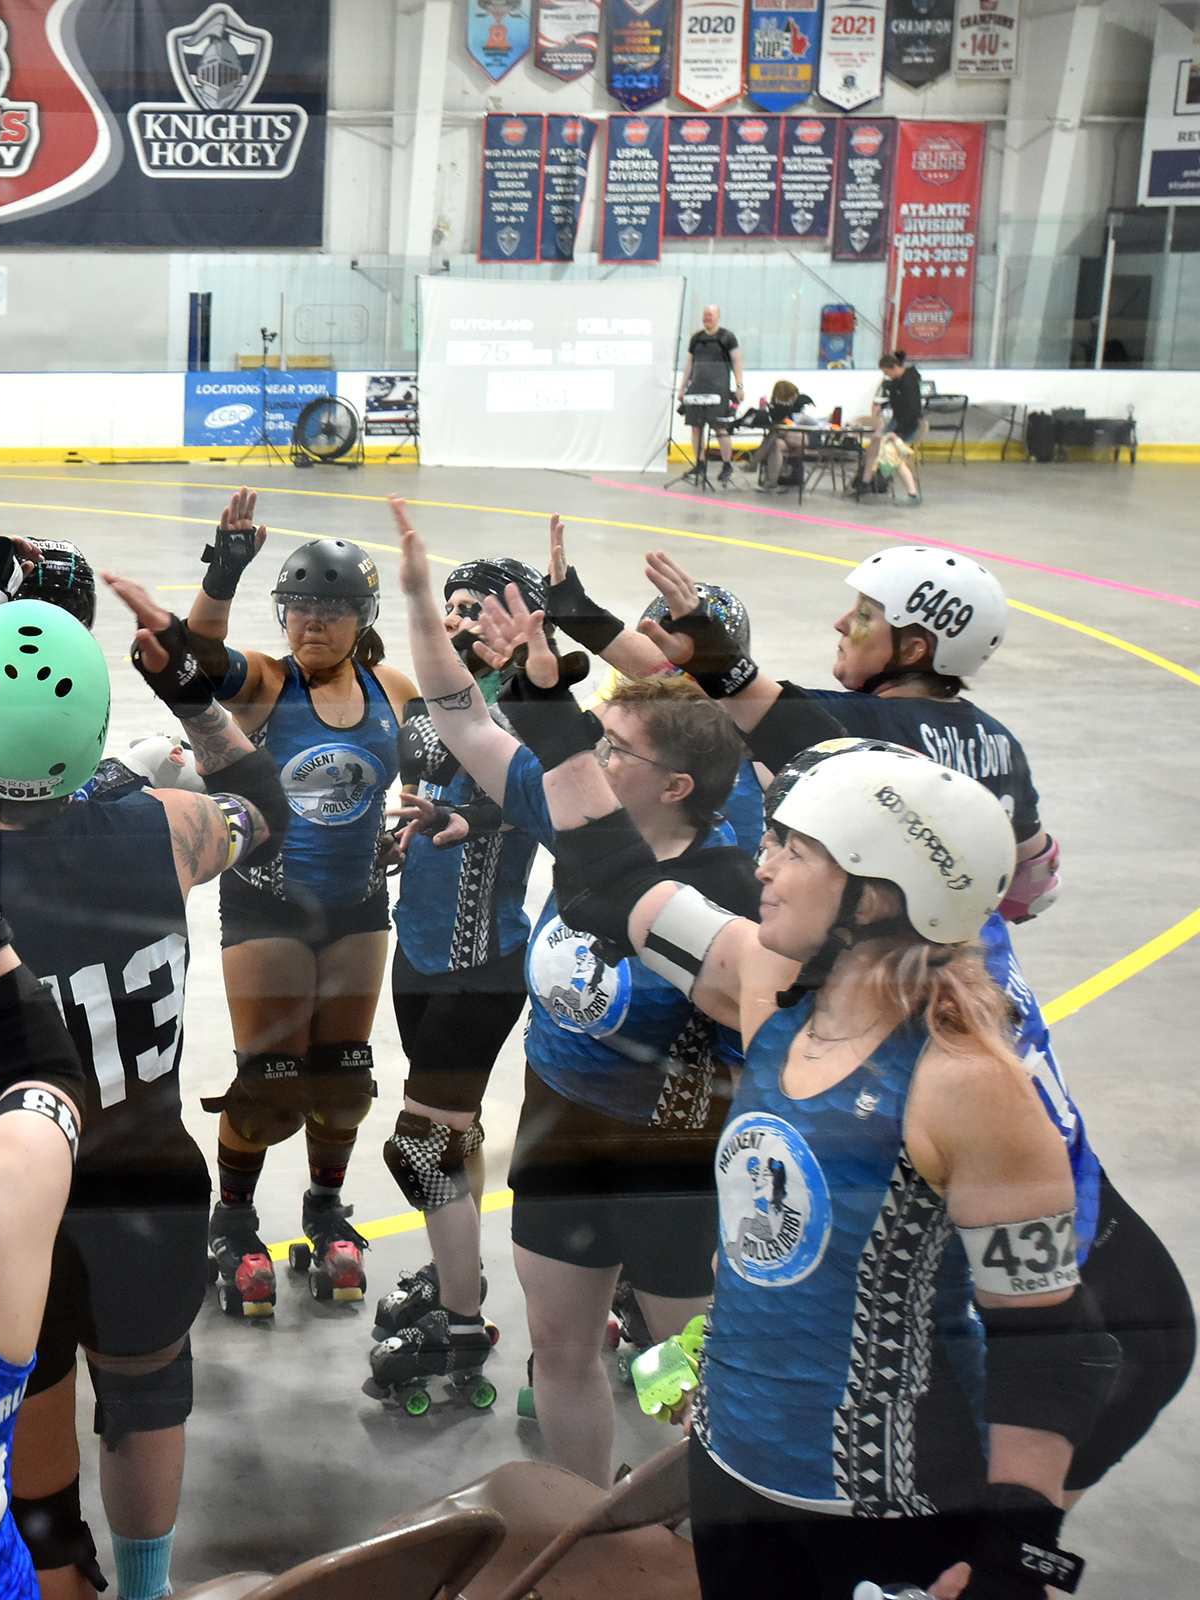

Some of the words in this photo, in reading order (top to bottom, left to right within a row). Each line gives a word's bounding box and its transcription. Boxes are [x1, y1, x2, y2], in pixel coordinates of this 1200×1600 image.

[688, 16, 735, 34] 2020
[831, 16, 876, 34] 2021
[612, 75, 659, 89] 2021
[143, 114, 293, 141] KNIGHTS
[150, 141, 285, 167] HOCKEY
[616, 148, 654, 159] USPHL
[609, 160, 659, 170] PREMIER
[608, 170, 658, 181] DIVISION
[900, 203, 970, 217] ATLANTIC
[903, 218, 965, 232] DIVISION
[893, 233, 974, 248] CHAMPIONS
[901, 248, 969, 263] 024-2025
[449, 318, 534, 331] DUTCHLAND
[479, 342, 510, 363] 75
[196, 384, 261, 395] LOCATIONS
[265, 384, 295, 395] NEAR
[300, 384, 327, 395] YOU!
[211, 408, 247, 422] LCBC
[905, 580, 973, 638] 6469
[721, 658, 749, 687] 187
[293, 753, 336, 782] PATUXENT
[37, 777, 60, 787] TO
[322, 799, 353, 814] ROLLER
[875, 786, 904, 815] RED
[901, 812, 955, 876] PEPPER
[554, 998, 587, 1024] ROLLER
[584, 989, 610, 1021] DERBY
[342, 1050, 370, 1060] 187
[266, 1061, 296, 1073] 187
[718, 1131, 767, 1174] PATUXENT
[742, 1235, 782, 1262] ROLLER
[779, 1206, 803, 1249] DERBY
[1011, 1269, 1049, 1292] Red
[1021, 1555, 1069, 1581] 187
